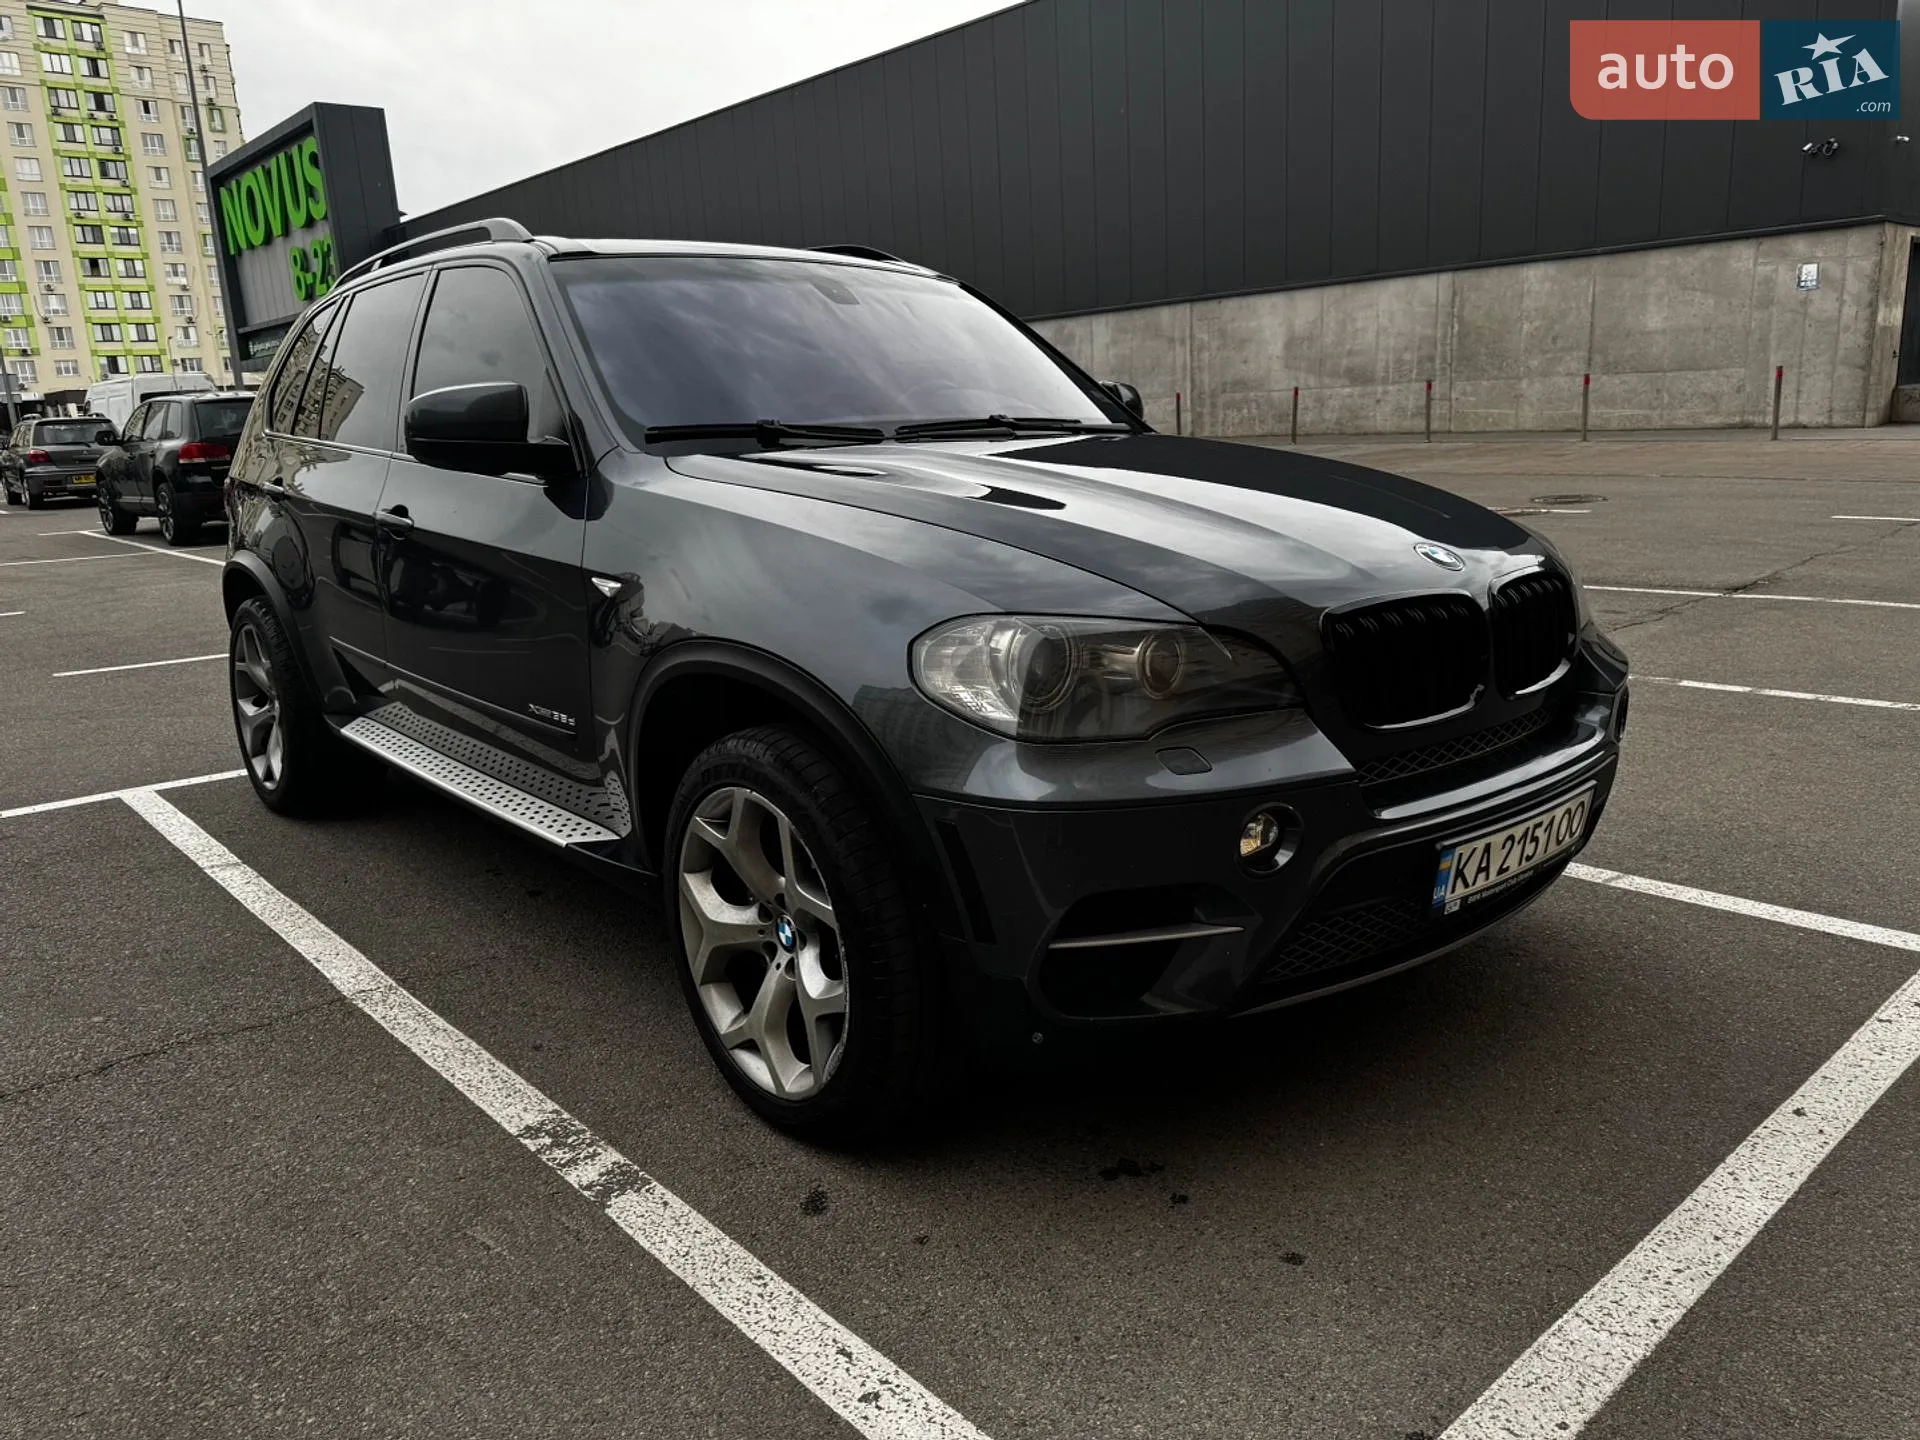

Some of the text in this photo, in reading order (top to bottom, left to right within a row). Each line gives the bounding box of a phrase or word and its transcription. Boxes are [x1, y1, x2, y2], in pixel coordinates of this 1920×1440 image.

[219, 136, 328, 256] NOVUS
[1451, 842, 1492, 893] KA
[1496, 815, 1556, 877] 2151
